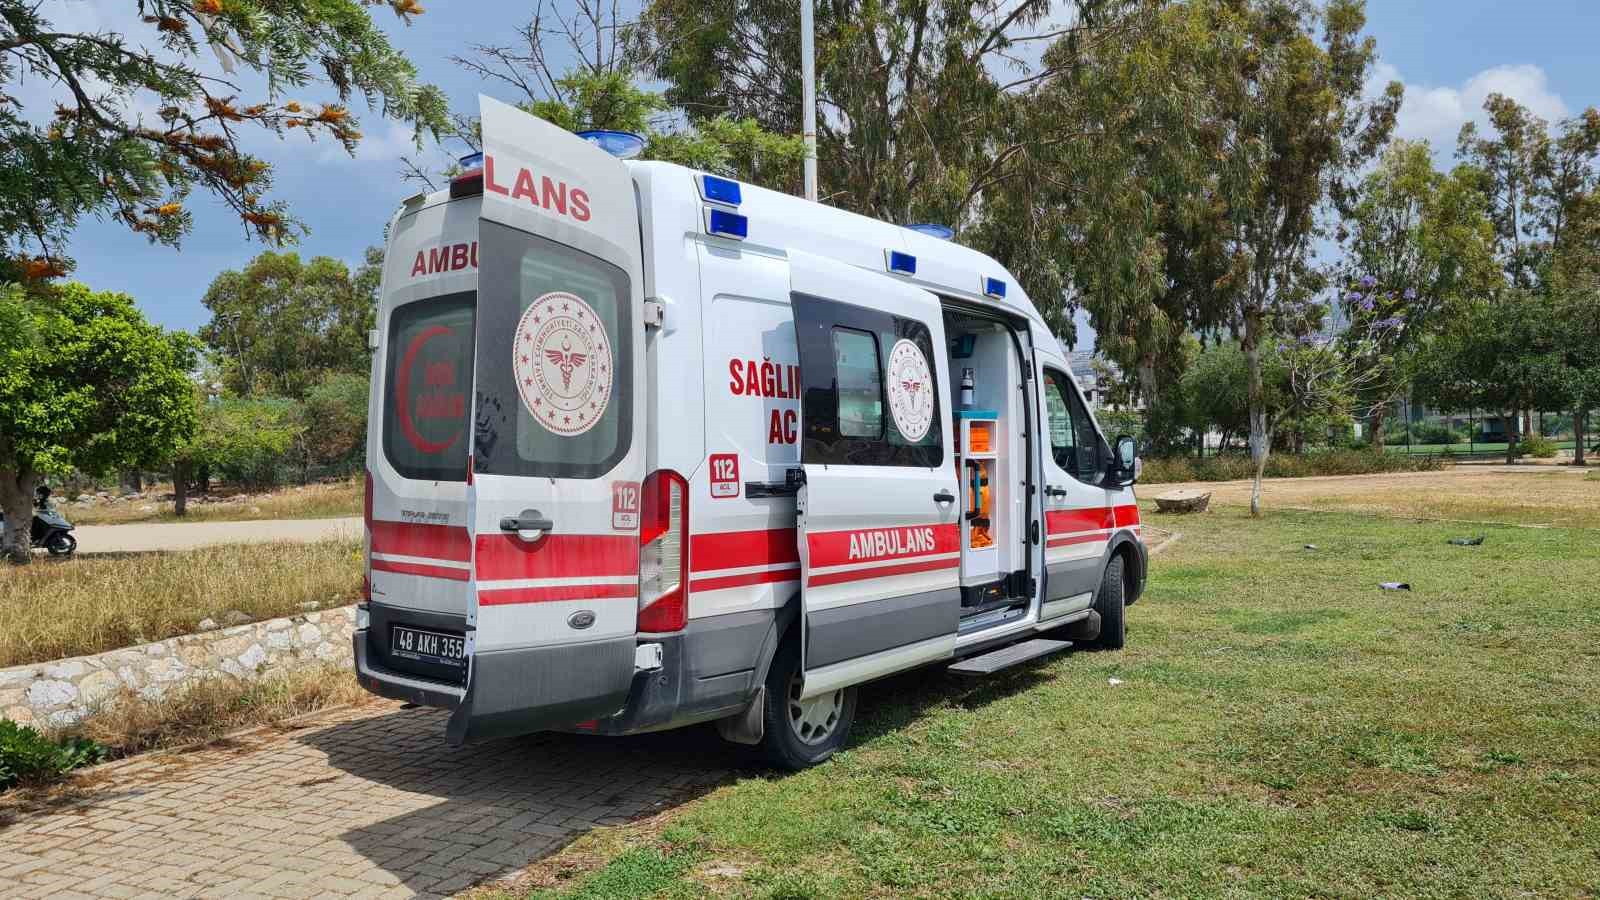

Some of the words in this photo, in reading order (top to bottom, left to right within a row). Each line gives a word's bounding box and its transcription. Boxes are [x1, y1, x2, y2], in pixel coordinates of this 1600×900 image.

[485, 155, 591, 222] LANS
[713, 458, 735, 480] 112
[617, 486, 637, 509] 112
[849, 527, 936, 560] AMBULANS
[399, 630, 413, 651] 48
[417, 634, 438, 655] AKH
[441, 638, 463, 659] 355
